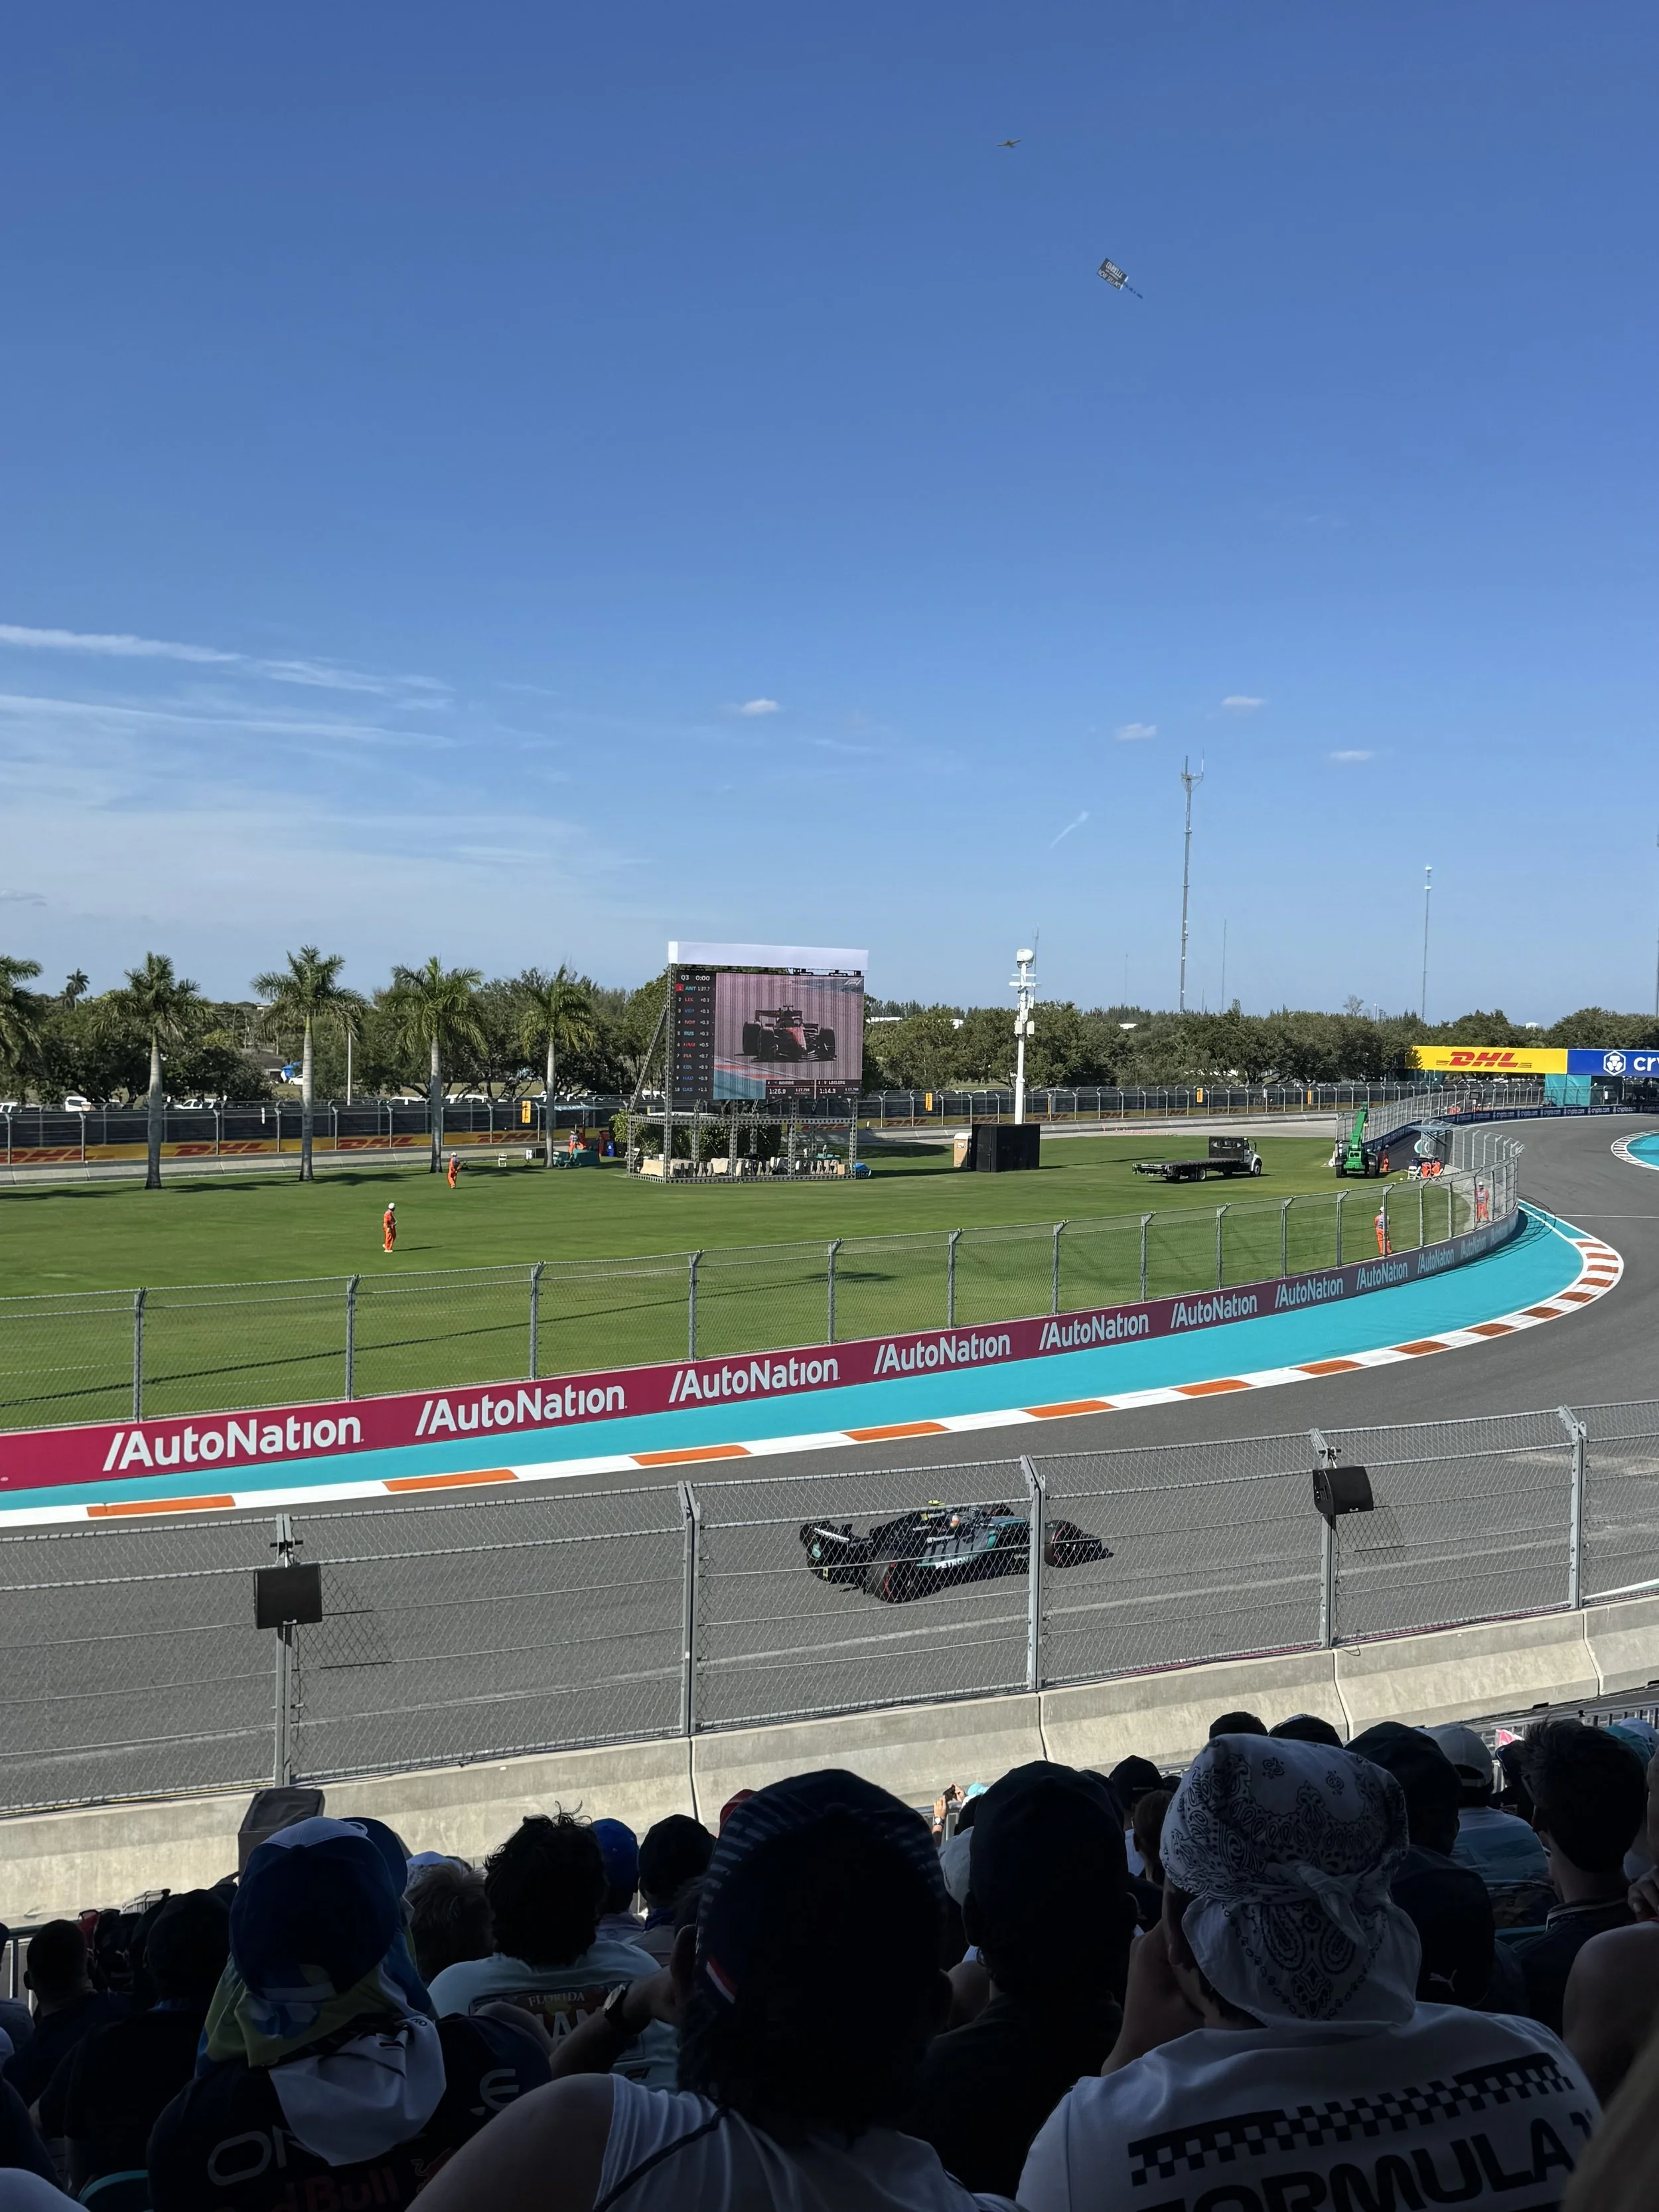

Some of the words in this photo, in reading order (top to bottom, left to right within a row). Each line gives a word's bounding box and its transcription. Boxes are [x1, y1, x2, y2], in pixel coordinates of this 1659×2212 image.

[1449, 1051, 1518, 1068] DHL
[1633, 1057, 1659, 1072] cr
[528, 1991, 585, 2007] FLORIDA
[1137, 2118, 1574, 2212] RMULA
